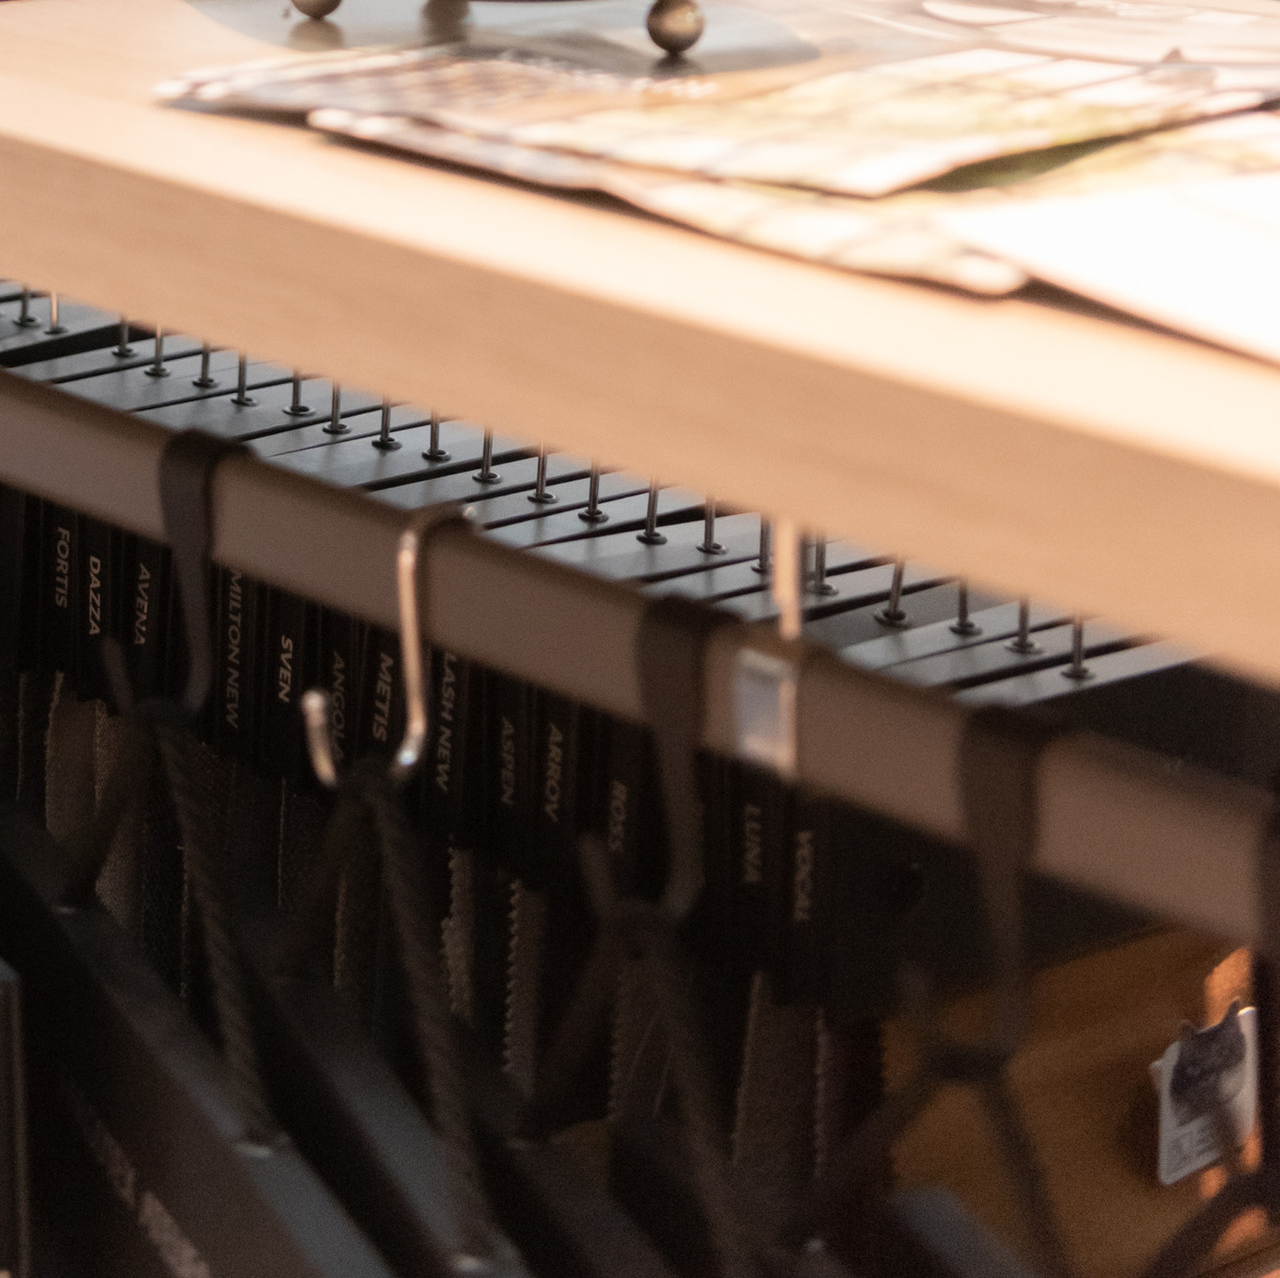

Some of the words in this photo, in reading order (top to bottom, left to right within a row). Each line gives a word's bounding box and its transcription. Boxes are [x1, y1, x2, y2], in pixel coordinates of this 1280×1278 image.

[54, 525, 71, 609] FORTIS
[87, 555, 102, 637] DAZZA
[133, 562, 152, 646] AVENA
[224, 666, 240, 729] NEW
[277, 634, 294, 705] SVEN
[371, 652, 395, 743] METIS
[435, 725, 454, 793] NEW
